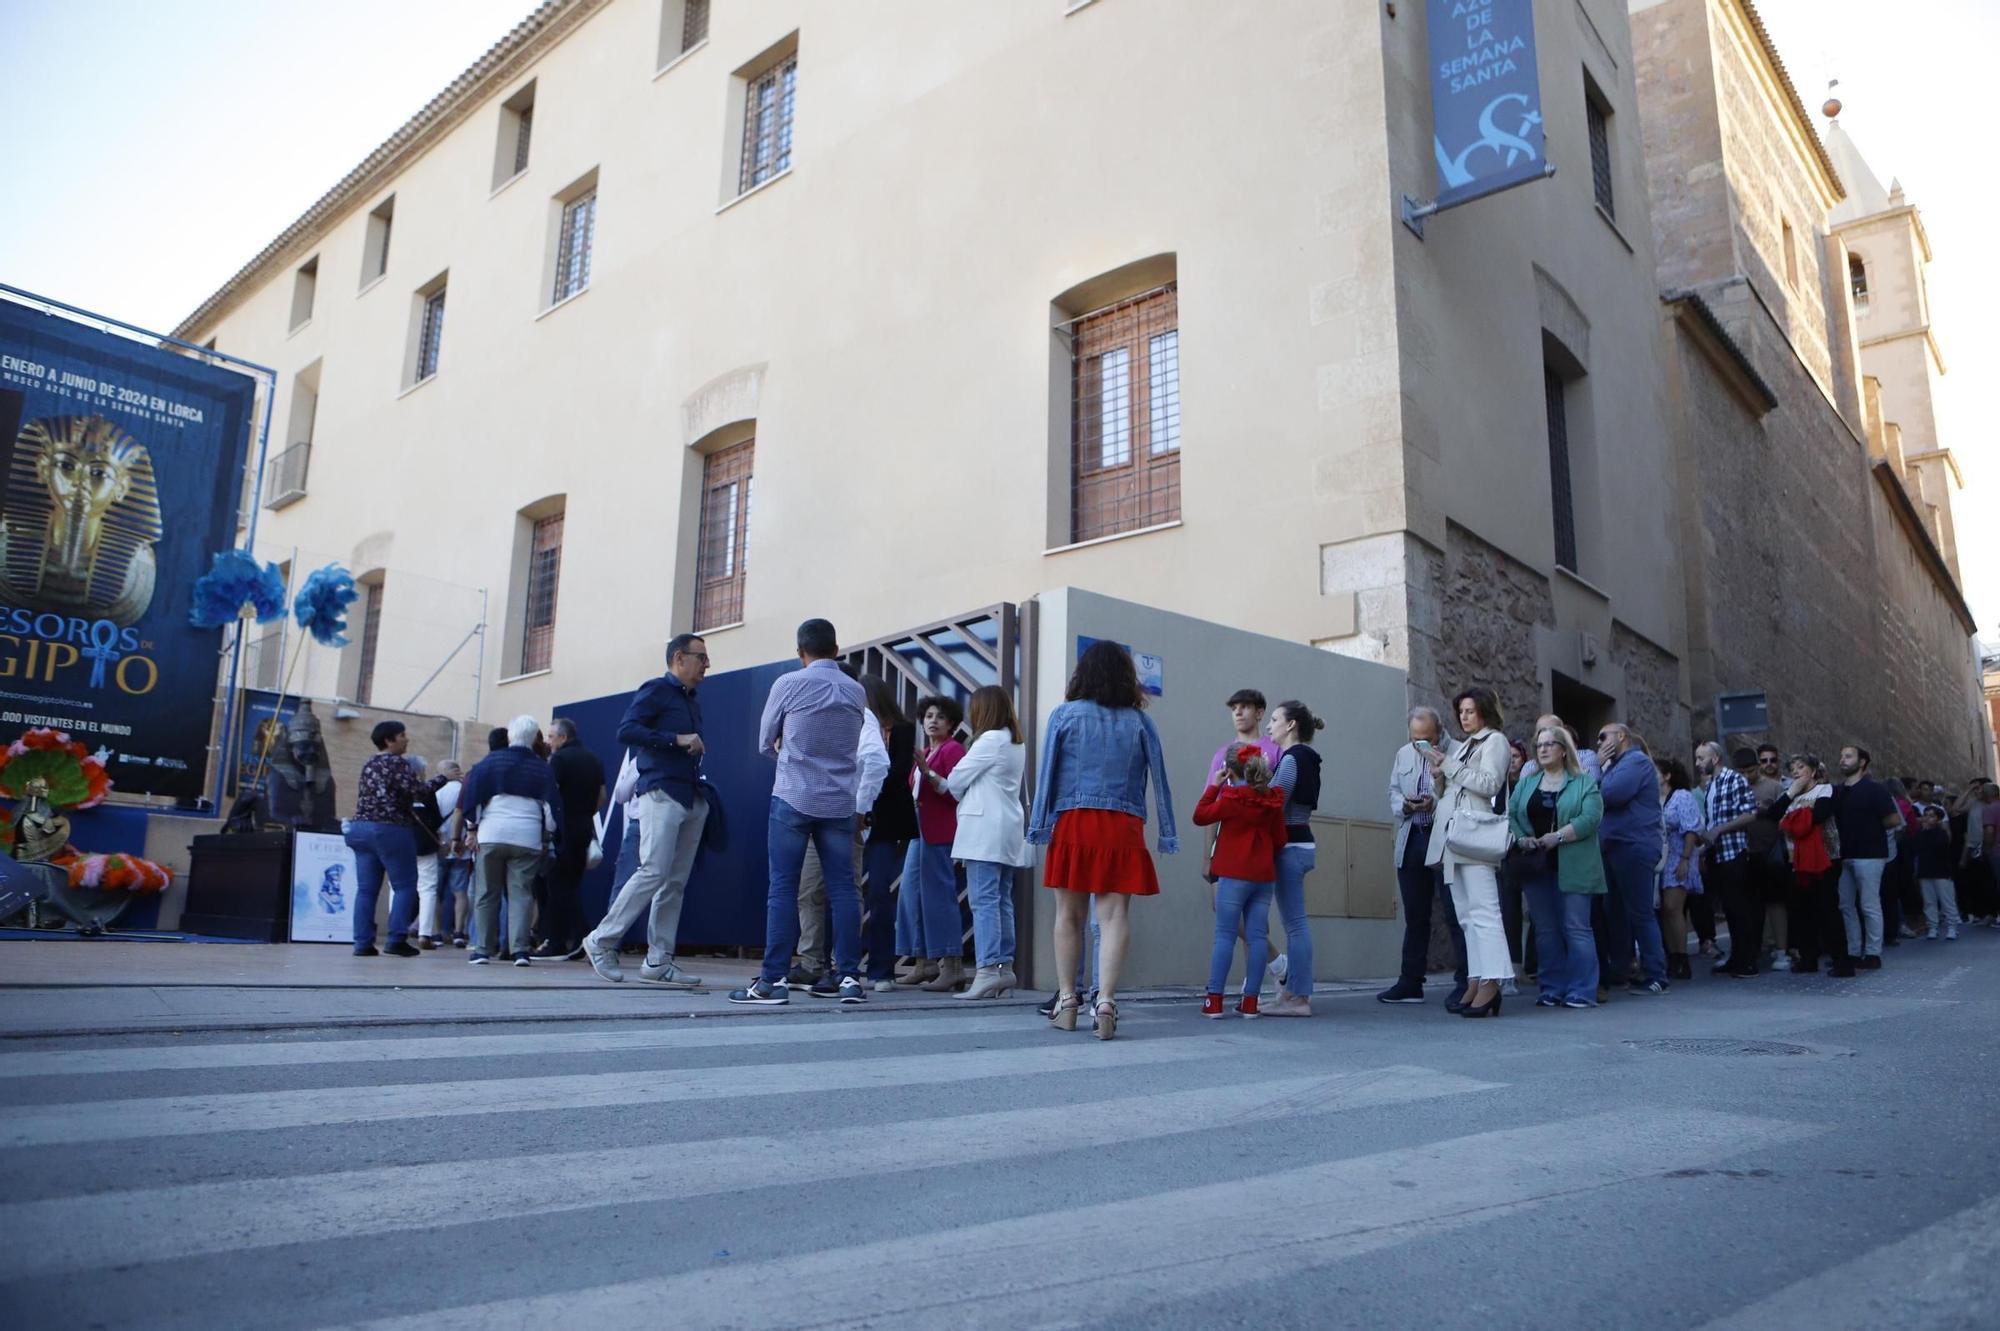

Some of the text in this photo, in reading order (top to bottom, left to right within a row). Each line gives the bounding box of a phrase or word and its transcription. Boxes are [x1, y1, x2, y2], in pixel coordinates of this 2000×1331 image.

[1452, 0, 1492, 18] AZ
[1466, 9, 1493, 30] DE
[1467, 29, 1494, 48] LA
[1440, 35, 1525, 78] SEMANA
[1450, 59, 1517, 94] SANTA
[1, 355, 203, 424] ENERO A JUNIO DE 2024 EN LORCA
[3, 372, 184, 428] MUSEO AZUL DE LA SEMANA SANTA
[24, 714, 73, 729] VISITANTES
[74, 719, 88, 731] EN
[88, 721, 99, 732] EL
[100, 723, 131, 736] MUNDO
